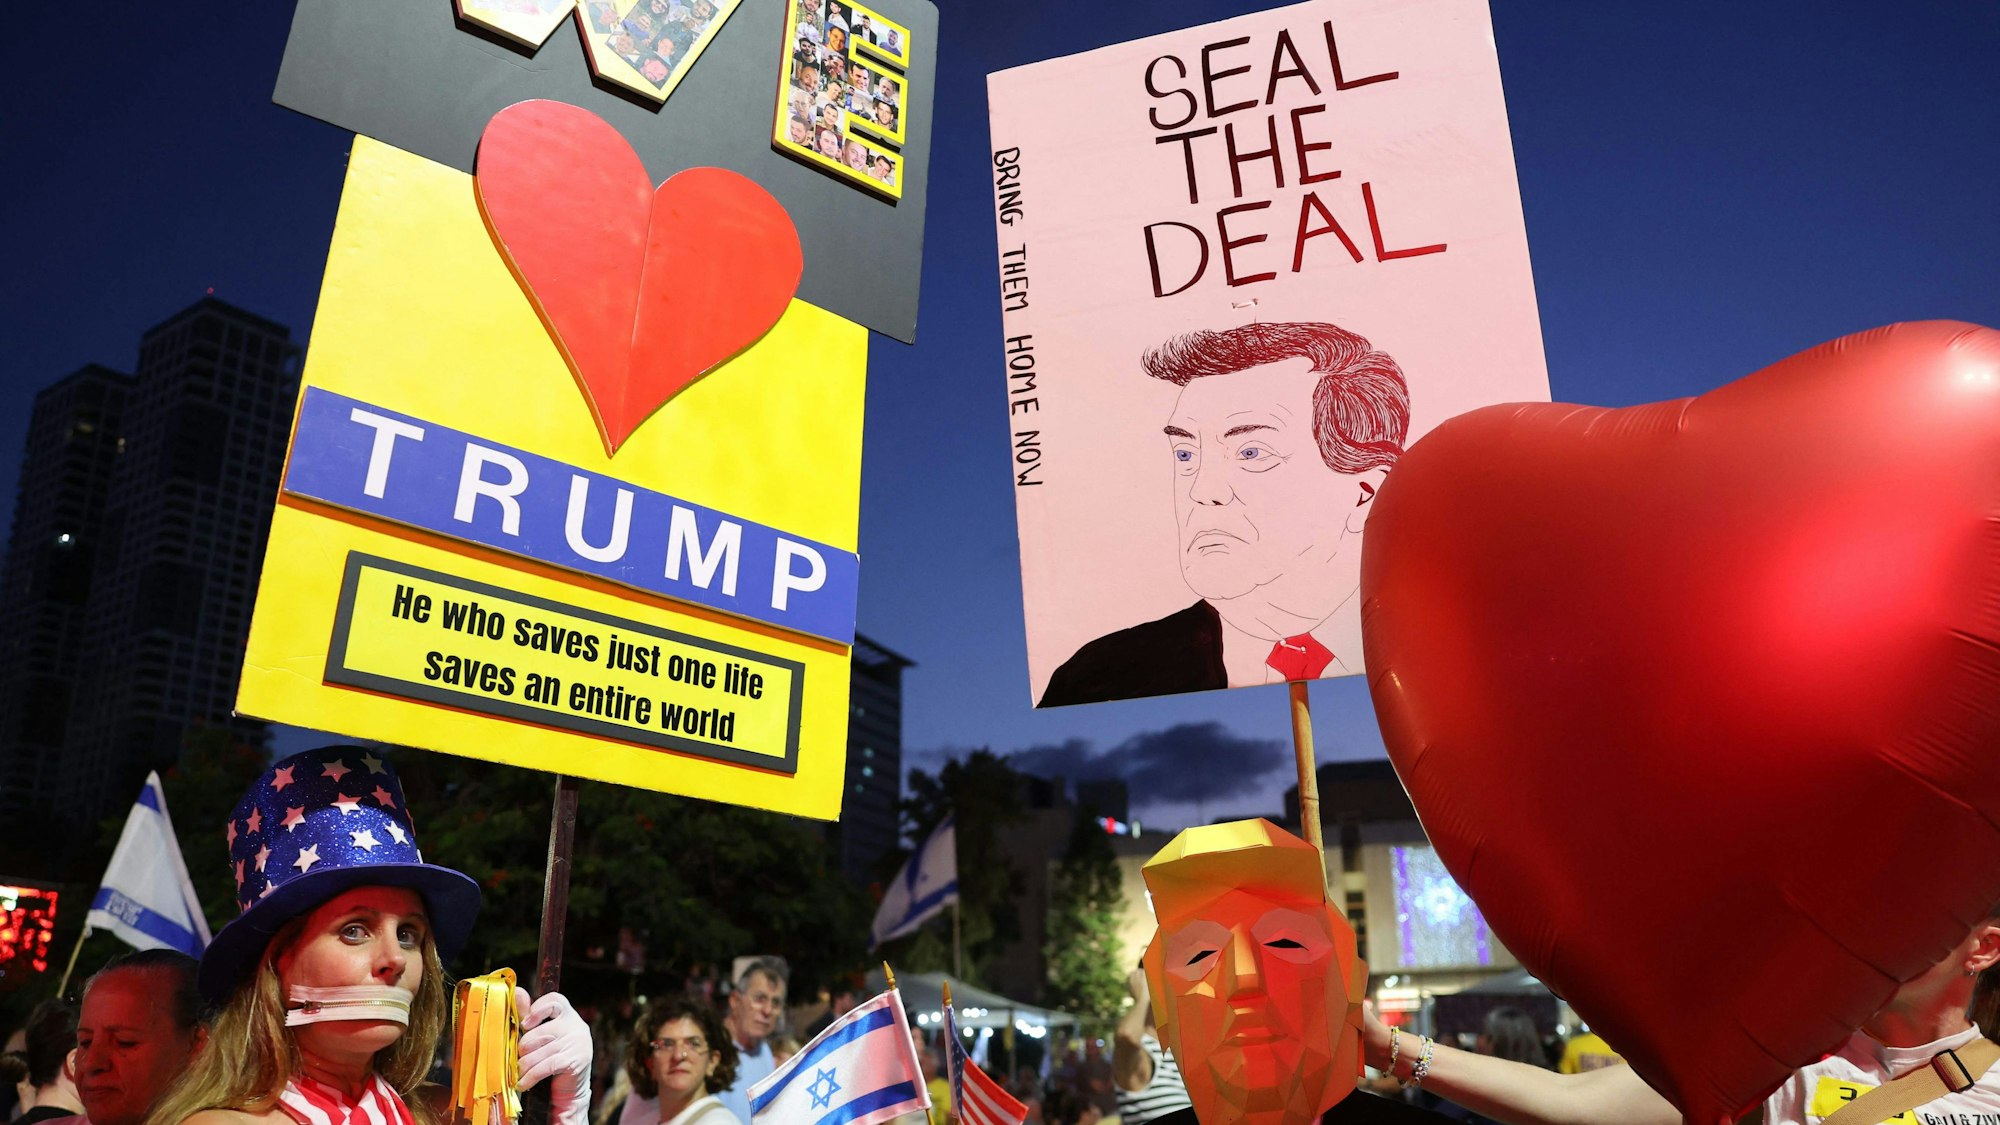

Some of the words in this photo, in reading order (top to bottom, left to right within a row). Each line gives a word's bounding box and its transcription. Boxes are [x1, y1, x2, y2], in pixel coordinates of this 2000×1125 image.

[1144, 21, 1399, 131] SEAL
[993, 147, 1024, 227] BRING
[1155, 104, 1342, 204] THE
[1002, 242, 1029, 312] THEM
[1143, 182, 1447, 298] DEAL
[1006, 335, 1040, 416] HOME
[1014, 431, 1044, 487] NOW
[350, 407, 827, 611] TRUMP
[391, 585, 432, 624] He
[442, 600, 505, 641] who
[513, 618, 600, 663] saves
[604, 634, 661, 677] just
[668, 654, 717, 689] one
[723, 662, 764, 700] life
[423, 651, 517, 696] saves
[523, 672, 561, 707] an
[568, 682, 652, 725] entire
[661, 701, 735, 743] world
